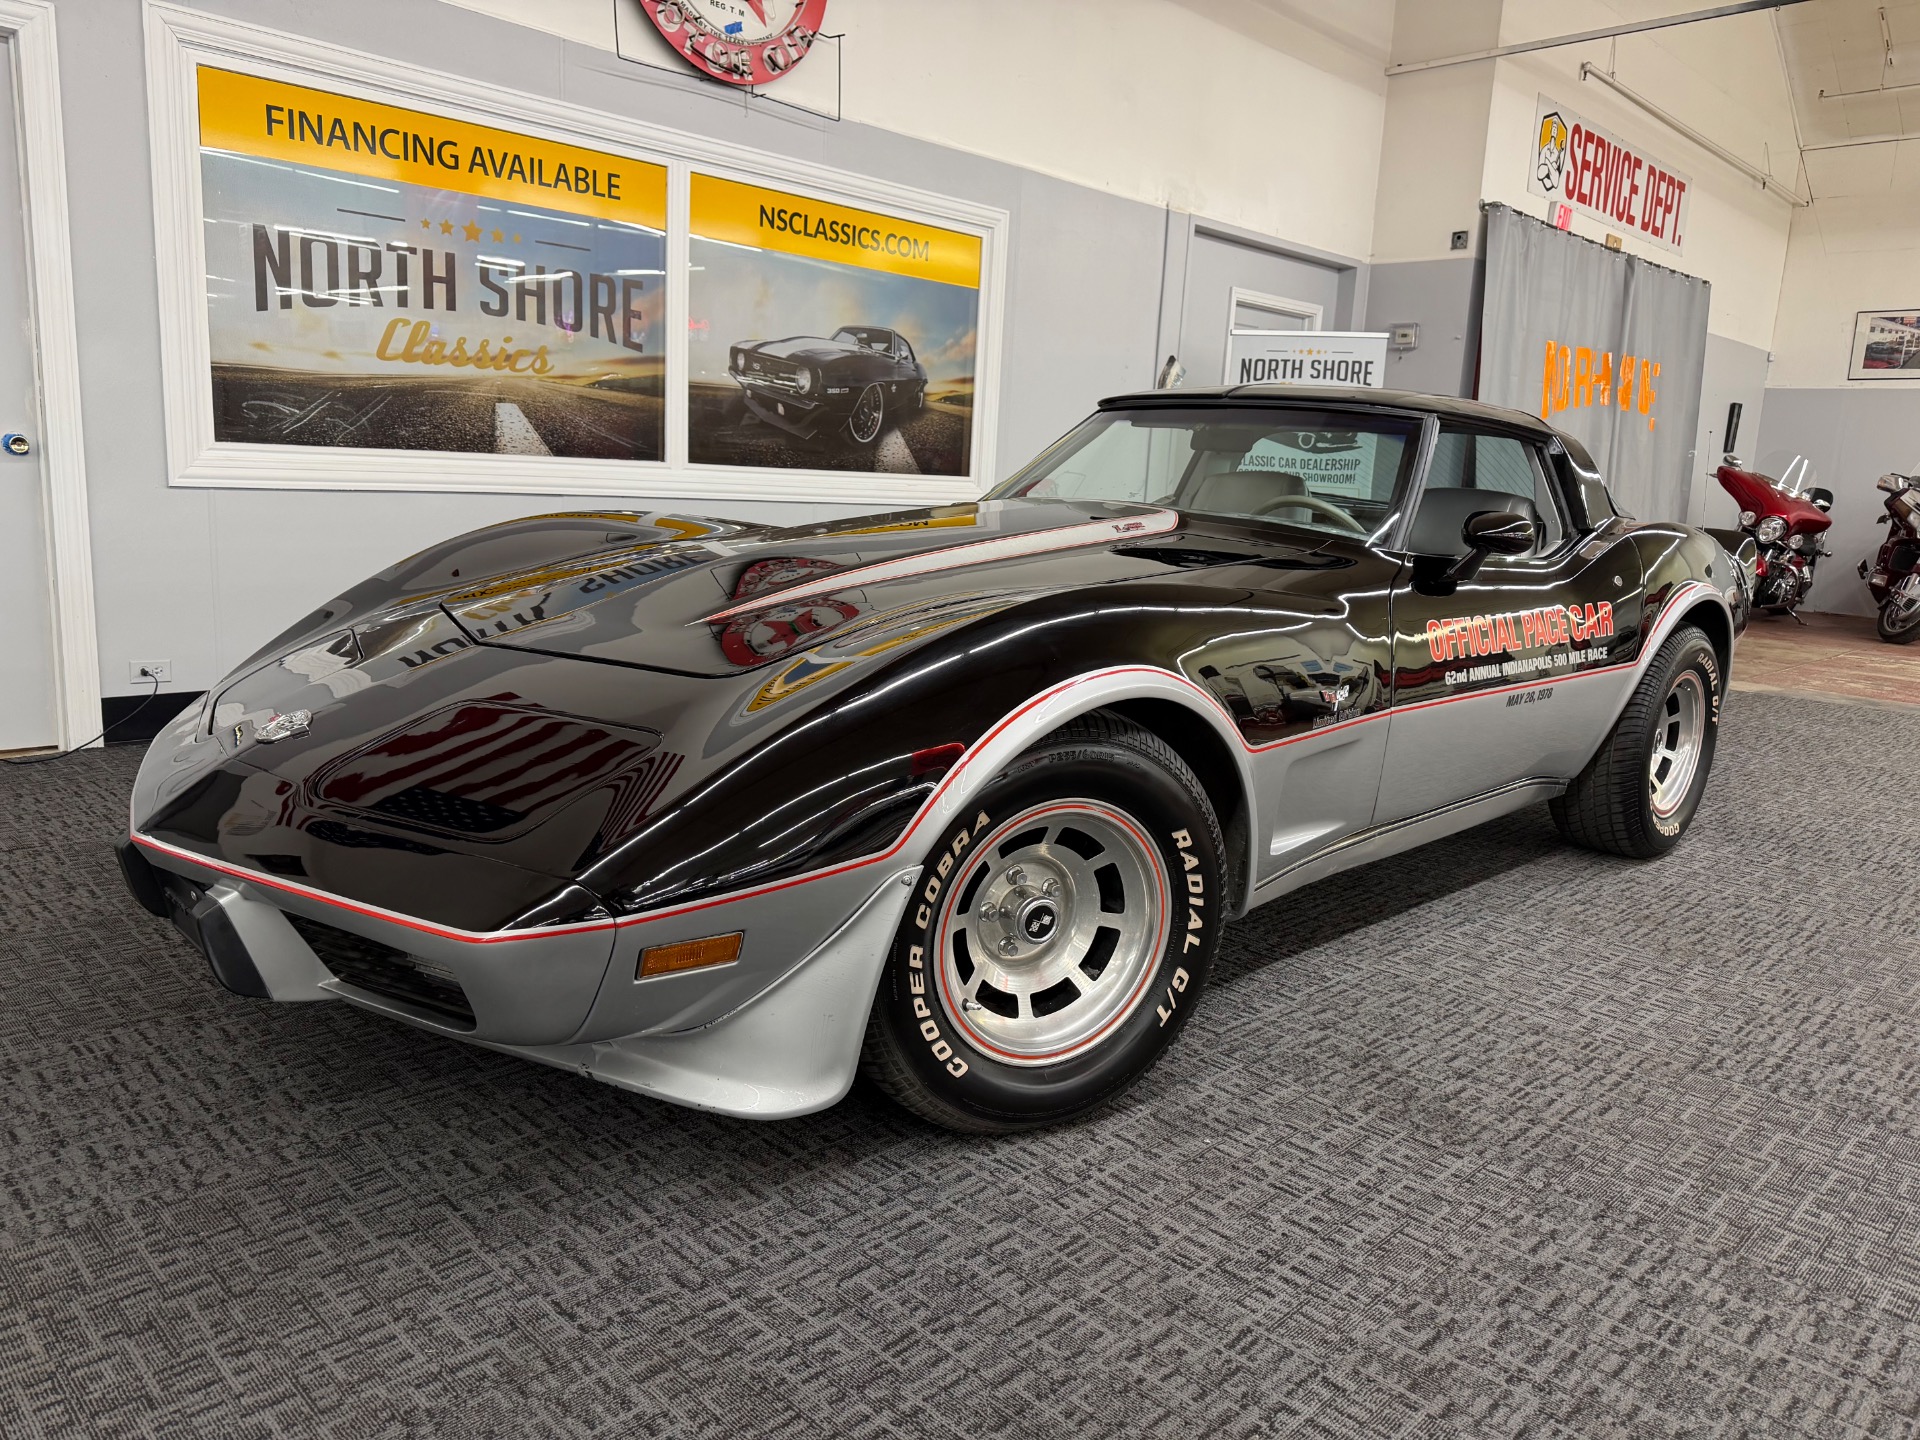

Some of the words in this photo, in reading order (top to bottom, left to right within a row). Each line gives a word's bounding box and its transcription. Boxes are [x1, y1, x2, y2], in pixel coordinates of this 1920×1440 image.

[645, 0, 753, 81] OTOR
[265, 104, 460, 170] FINANCING
[468, 147, 621, 200] AVAILABLE
[1565, 123, 1643, 227] SERVICE
[1640, 164, 1687, 247] DEPT.
[759, 204, 930, 262] NSCLASSICS.COM
[252, 223, 457, 312] NORTH
[479, 259, 645, 352] SHORE
[375, 317, 555, 375] Classics
[1240, 358, 1302, 384] NORTH
[1309, 359, 1374, 386] SHORE
[1241, 455, 1275, 467] LASSIC
[1278, 457, 1297, 469] CAR
[1299, 459, 1361, 471] DEALERSHIP
[1303, 472, 1356, 485] SHOWROOM!
[1426, 611, 1523, 662] OFFICIAL
[1521, 607, 1570, 648] PACE
[1569, 601, 1614, 644] CAR
[1445, 669, 1467, 686] 62nd
[1469, 664, 1502, 683] ANNUAL
[1502, 656, 1553, 677] INDIANAPOLIS
[1553, 655, 1568, 667] 500
[1568, 651, 1586, 664] MILE
[1587, 647, 1608, 661] RACE
[1506, 693, 1526, 707] MAY
[1523, 691, 1536, 704] 28,
[1537, 687, 1554, 701] 1978
[1696, 652, 1718, 691] RADIAL
[915, 810, 991, 929] COBRA
[1172, 827, 1205, 954] RADIAL
[909, 944, 969, 1078] COOPER
[1156, 967, 1190, 1028] G/T
